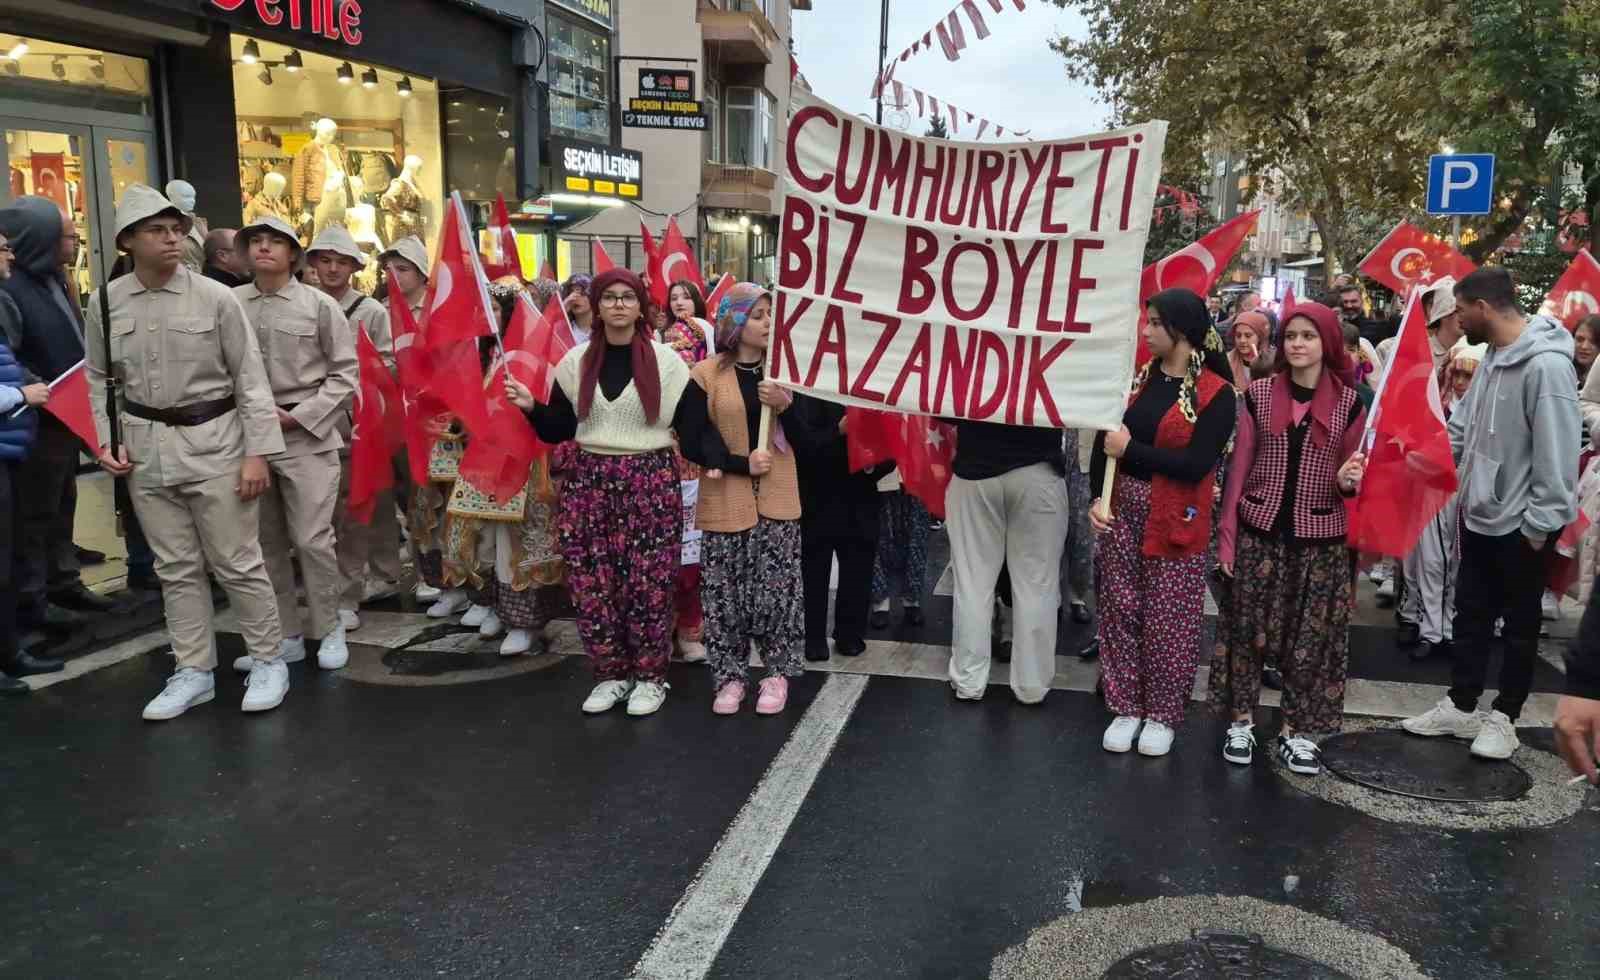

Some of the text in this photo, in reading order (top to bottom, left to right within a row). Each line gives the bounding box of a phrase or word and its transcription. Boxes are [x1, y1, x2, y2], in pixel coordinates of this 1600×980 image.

[636, 114, 705, 128] TEKNİK SERVİS
[564, 147, 640, 182] SEÇKİN İLETİŞİM
[786, 106, 1144, 232] CUMHURİYETİ
[1441, 161, 1478, 208] P
[778, 195, 1104, 334] BİZ BÖYLE
[770, 292, 1076, 427] KAZANDIK
